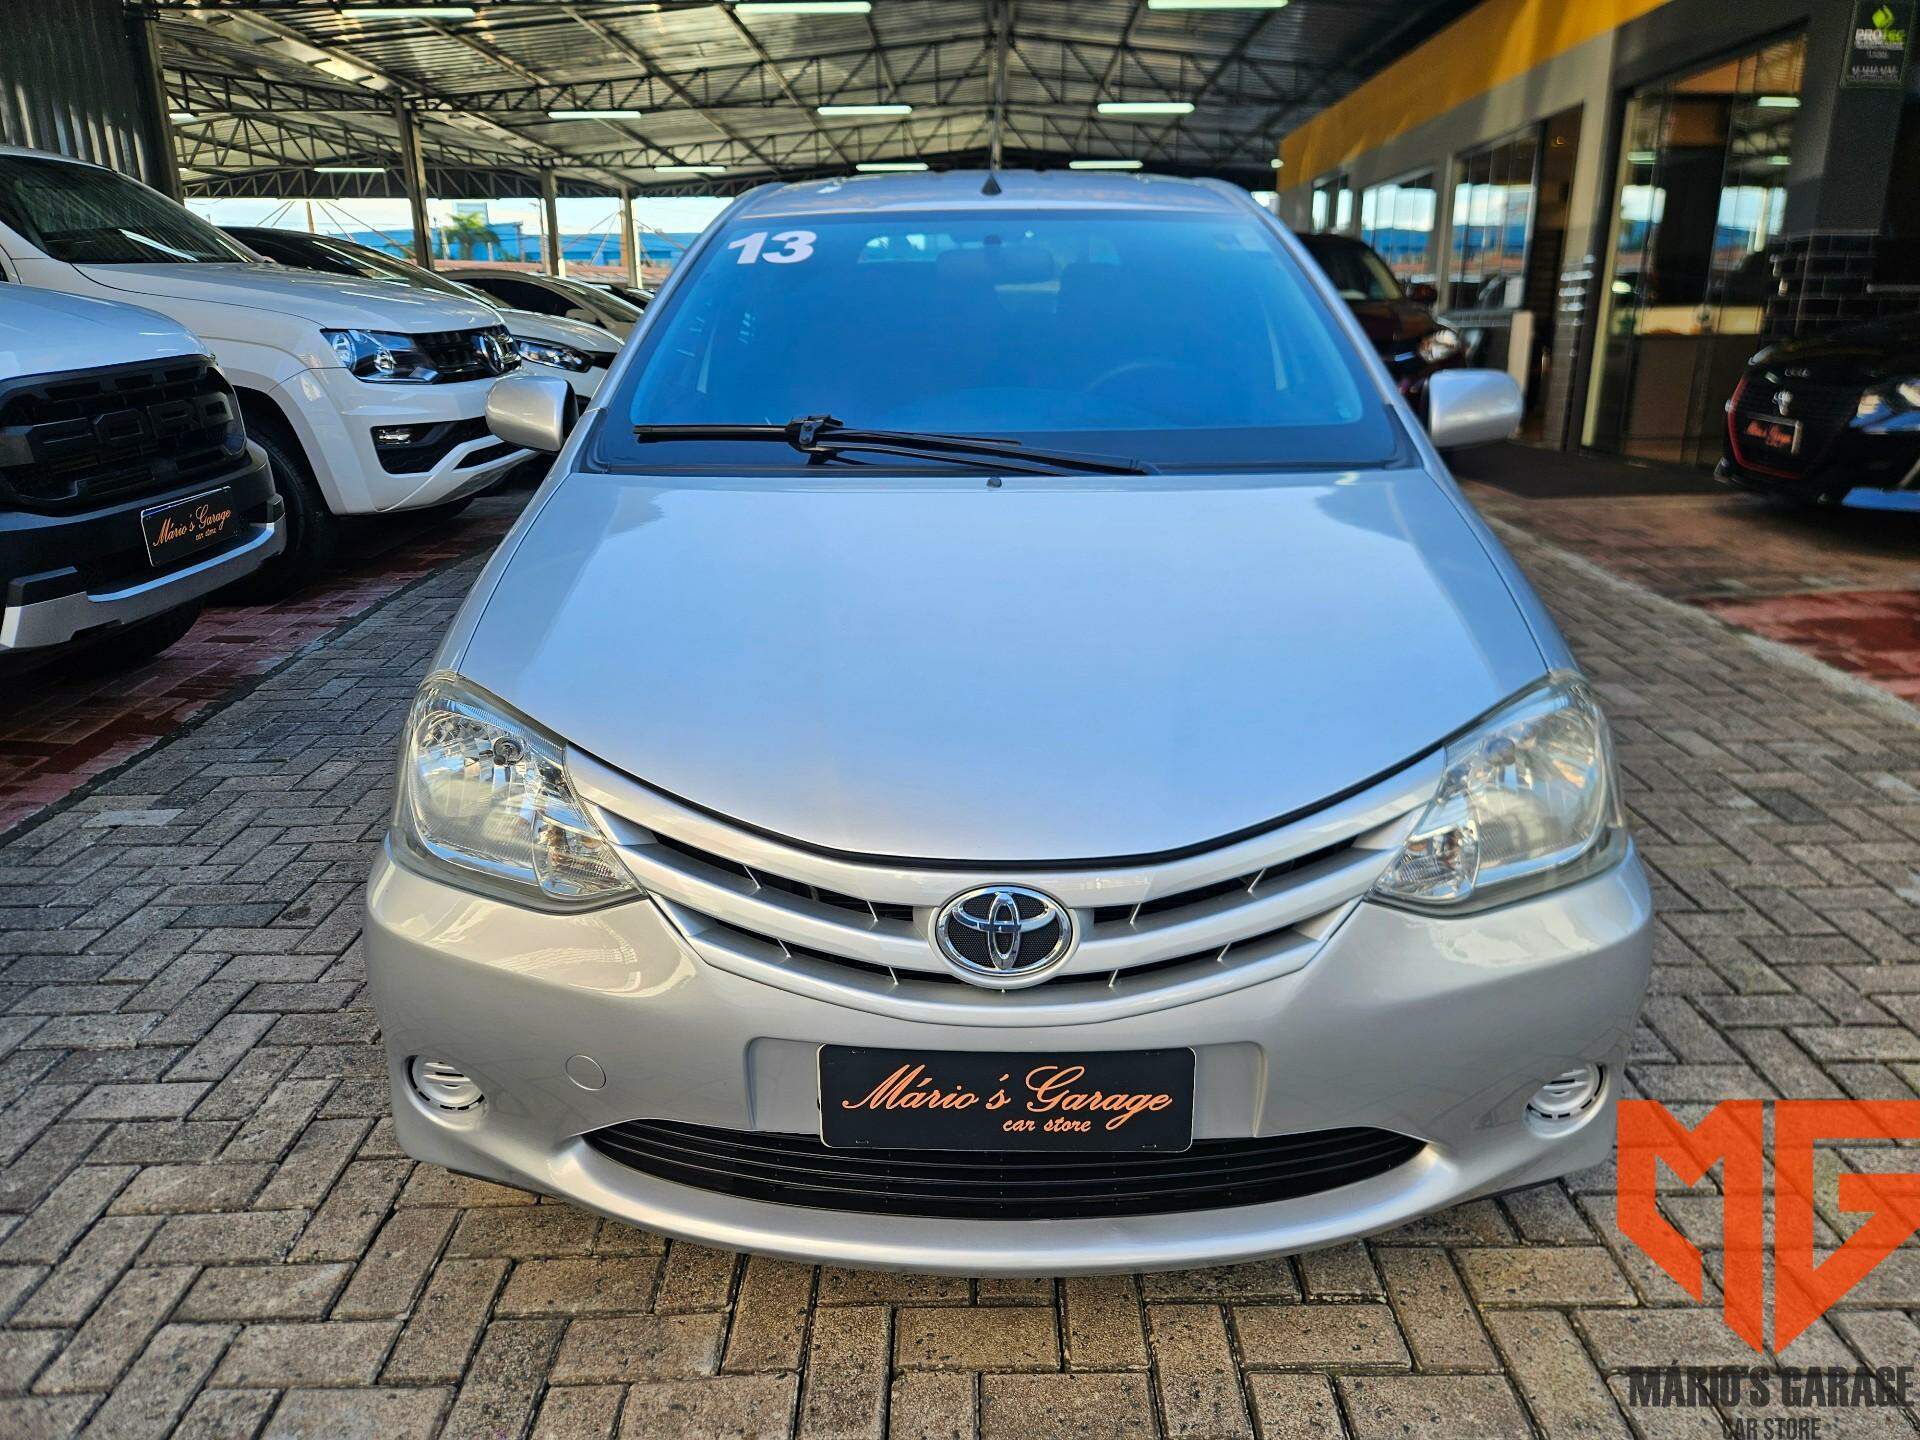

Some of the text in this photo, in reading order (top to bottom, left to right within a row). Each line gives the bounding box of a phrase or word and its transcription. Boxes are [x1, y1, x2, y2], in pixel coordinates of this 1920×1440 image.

[727, 230, 817, 265] 13
[195, 503, 232, 531] Garage
[1025, 1064, 1173, 1131] Garage
[1002, 1116, 1092, 1133] car store
